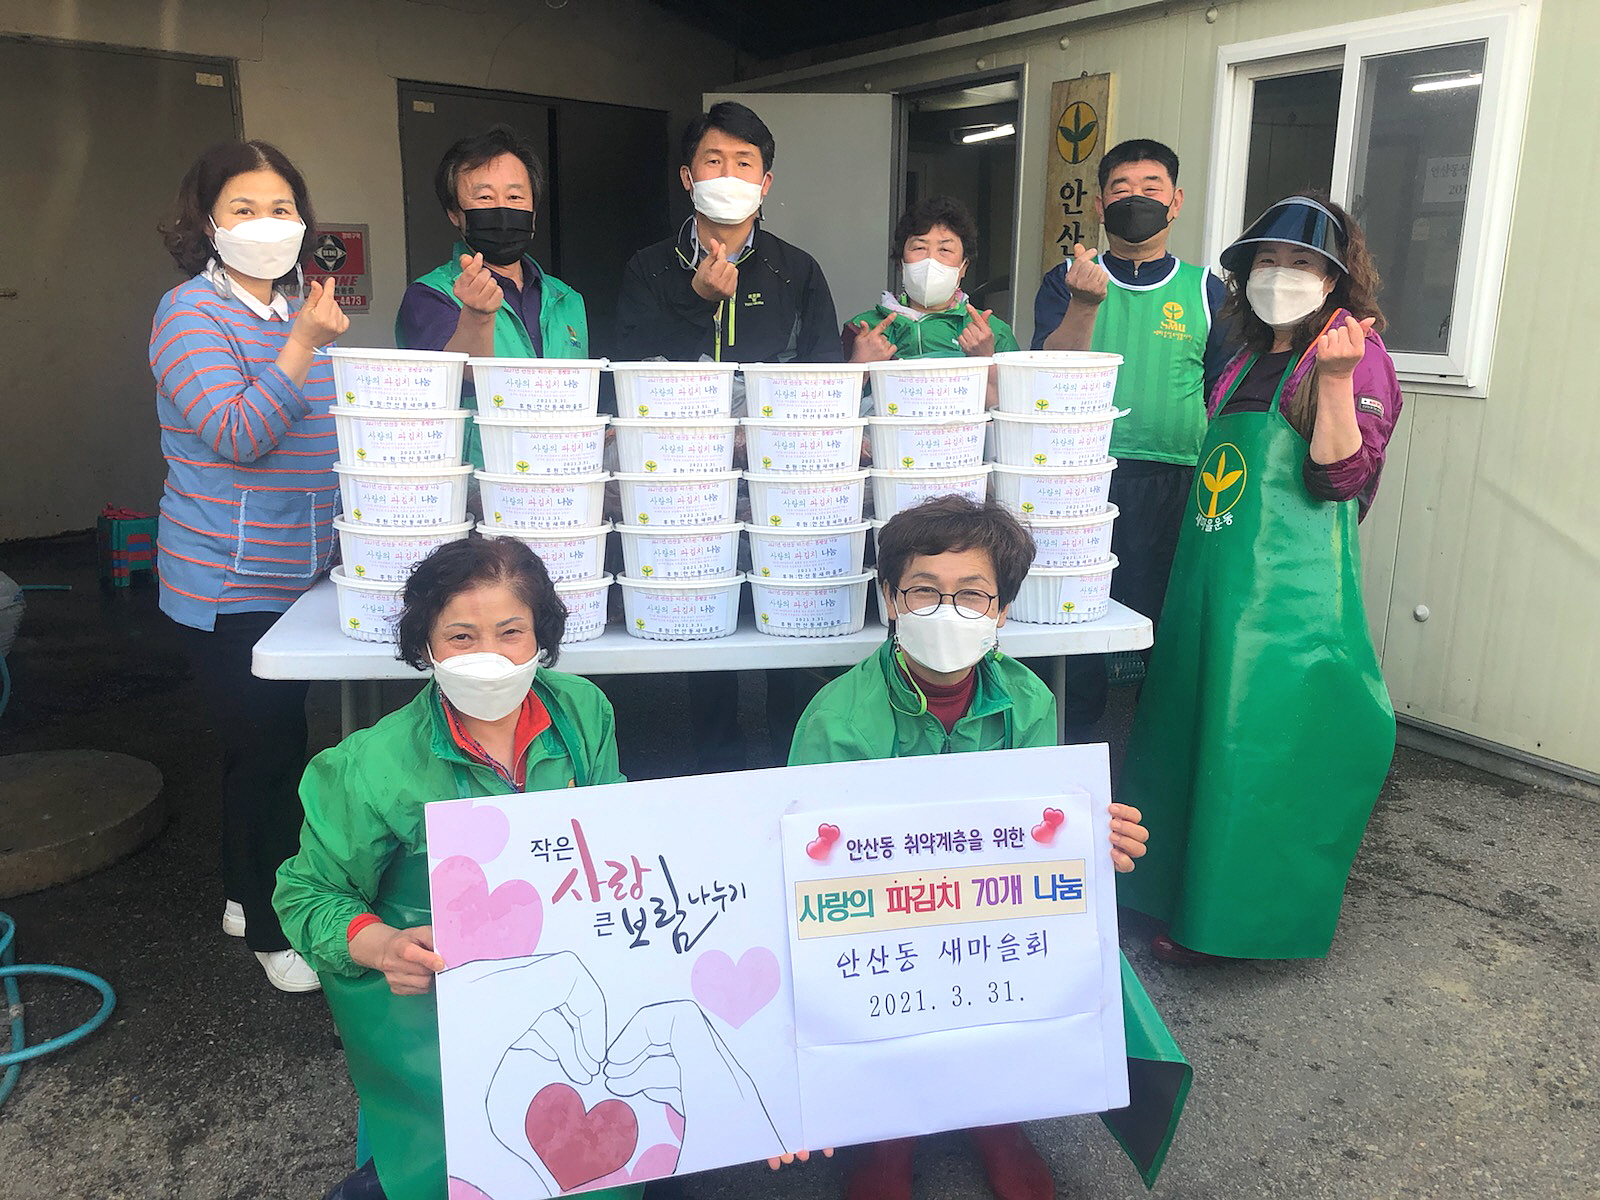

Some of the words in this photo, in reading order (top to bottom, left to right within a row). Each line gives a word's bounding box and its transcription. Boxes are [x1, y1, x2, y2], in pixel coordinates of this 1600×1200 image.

[1057, 178, 1088, 257] 안산
[530, 836, 574, 863] 작은
[551, 818, 652, 905] 사랑
[846, 834, 895, 862] 안산동
[904, 828, 983, 856] 취약계층을
[993, 825, 1025, 849] 위한
[593, 911, 616, 937] 큰
[688, 880, 746, 913] 나누기
[799, 889, 875, 923] 사랑의
[886, 875, 961, 914] 파김치
[971, 874, 1023, 907] 70개
[1034, 873, 1082, 902] 나눔
[836, 941, 918, 979] 안산동
[938, 929, 1049, 966] 새마을회
